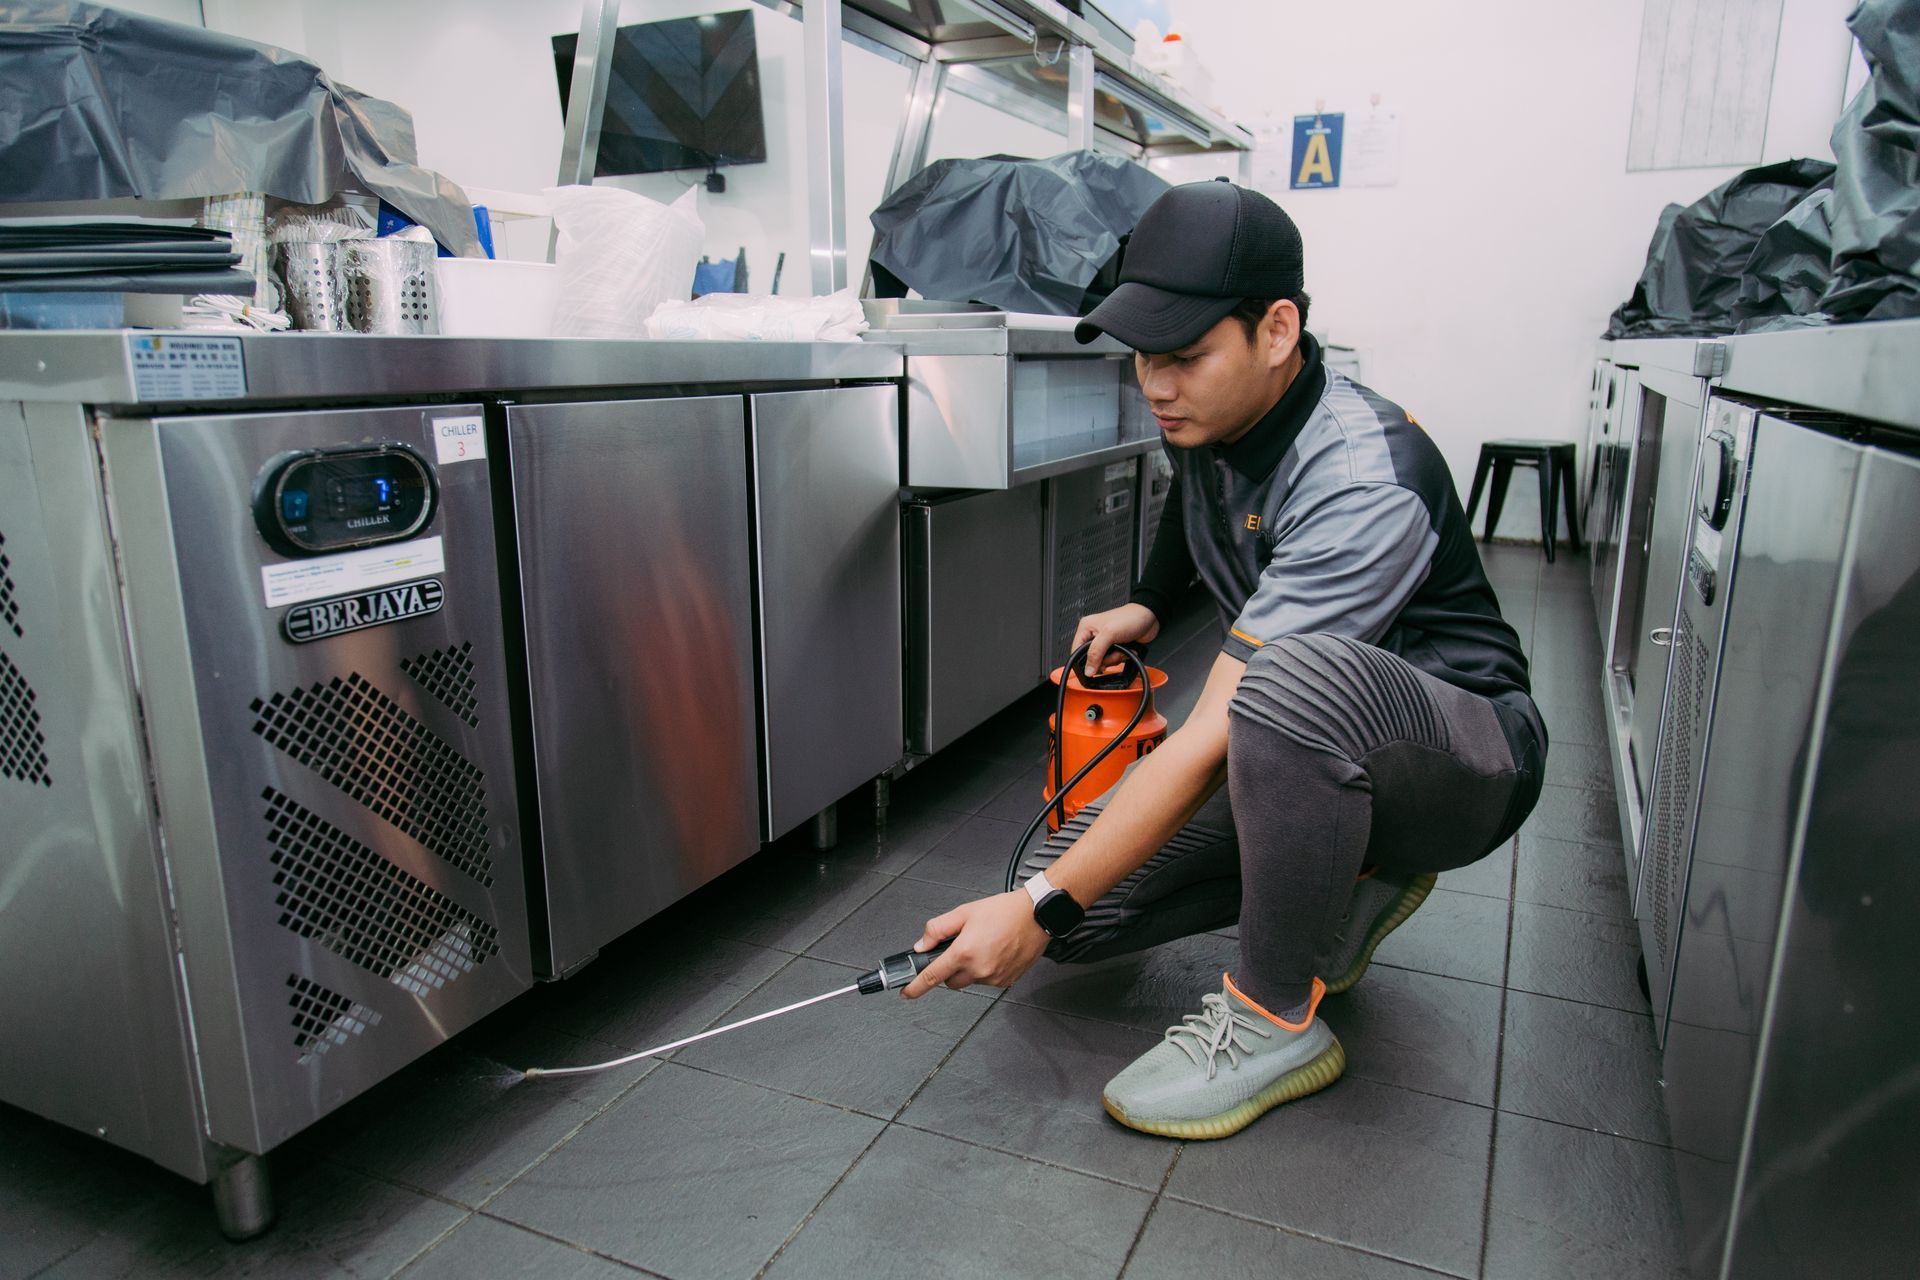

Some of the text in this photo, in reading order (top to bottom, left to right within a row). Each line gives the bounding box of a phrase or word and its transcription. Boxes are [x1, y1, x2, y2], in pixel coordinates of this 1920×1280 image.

[1298, 134, 1334, 183] A
[441, 423, 478, 438] CHILLER
[456, 440, 466, 457] 3
[346, 514, 390, 529] CHILLER
[309, 586, 426, 635] BERJAYA
